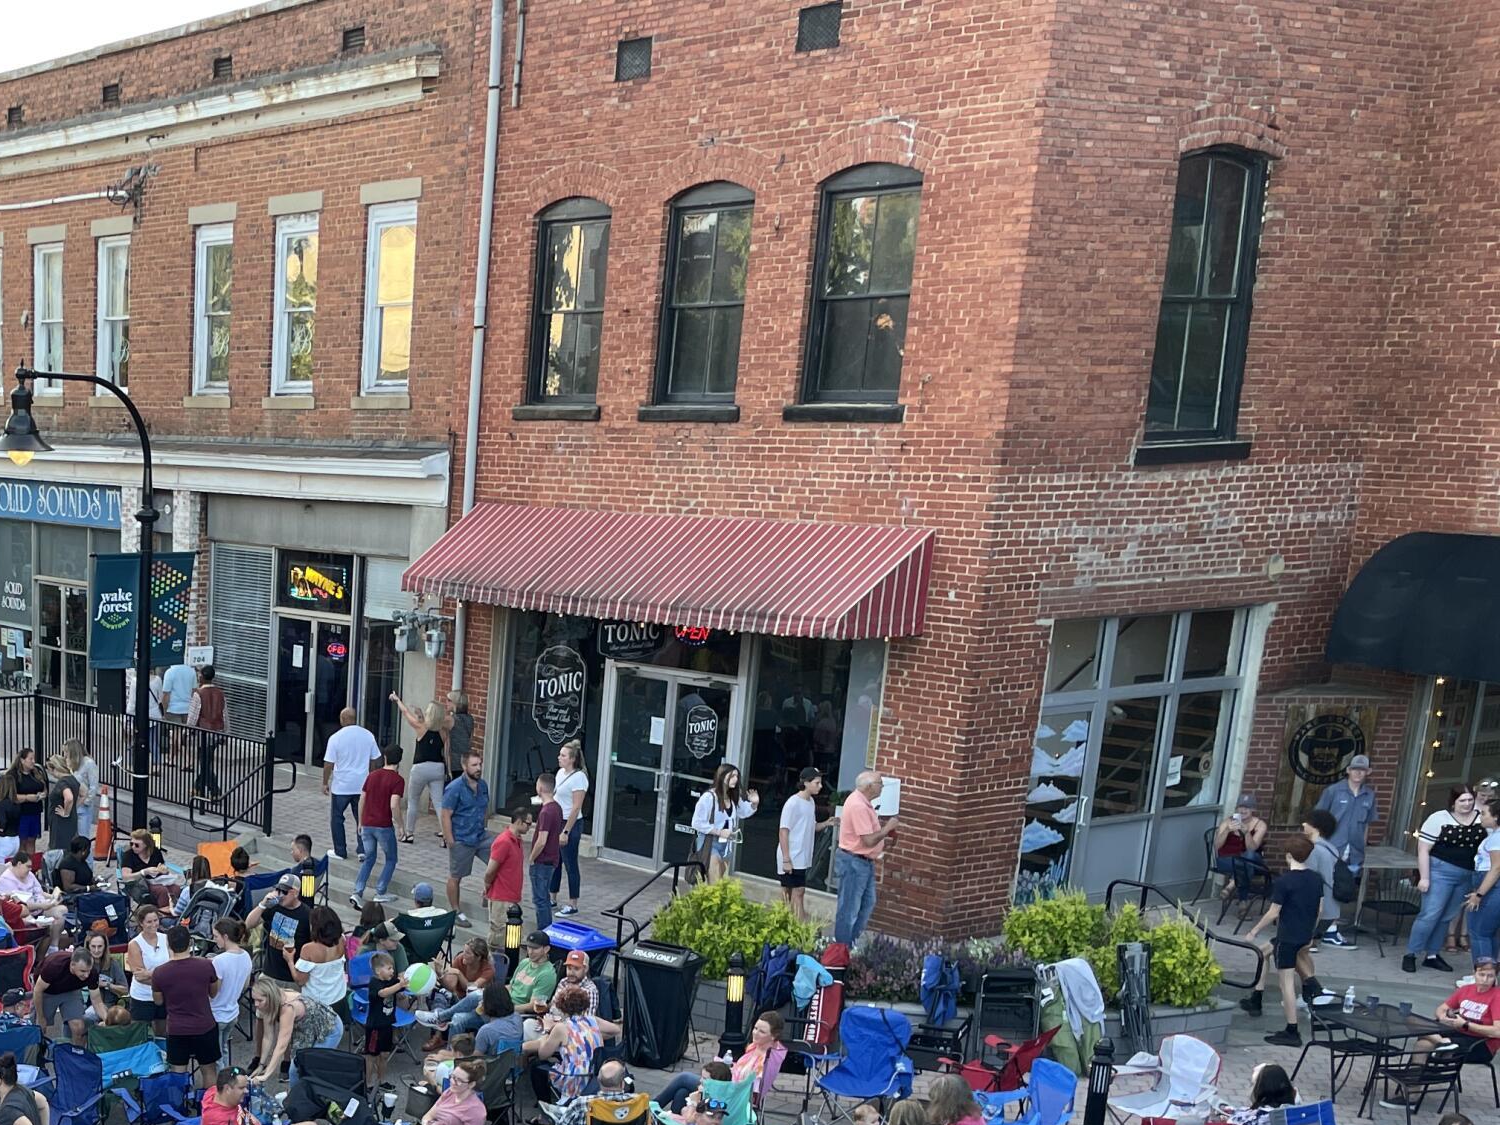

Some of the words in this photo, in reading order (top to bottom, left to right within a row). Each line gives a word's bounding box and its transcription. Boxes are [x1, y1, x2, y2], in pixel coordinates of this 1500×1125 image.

[37, 483, 101, 521] SOUNDS
[4, 580, 23, 596] SOLID
[101, 588, 133, 602] wake
[1, 596, 27, 612] SOUNDS
[94, 600, 133, 622] forest
[604, 623, 660, 644] TONIC
[675, 626, 711, 641] OPEN
[537, 670, 583, 698] TONIC
[688, 719, 716, 735] TONIC
[632, 948, 656, 960] TRASH
[655, 952, 678, 963] ONLY
